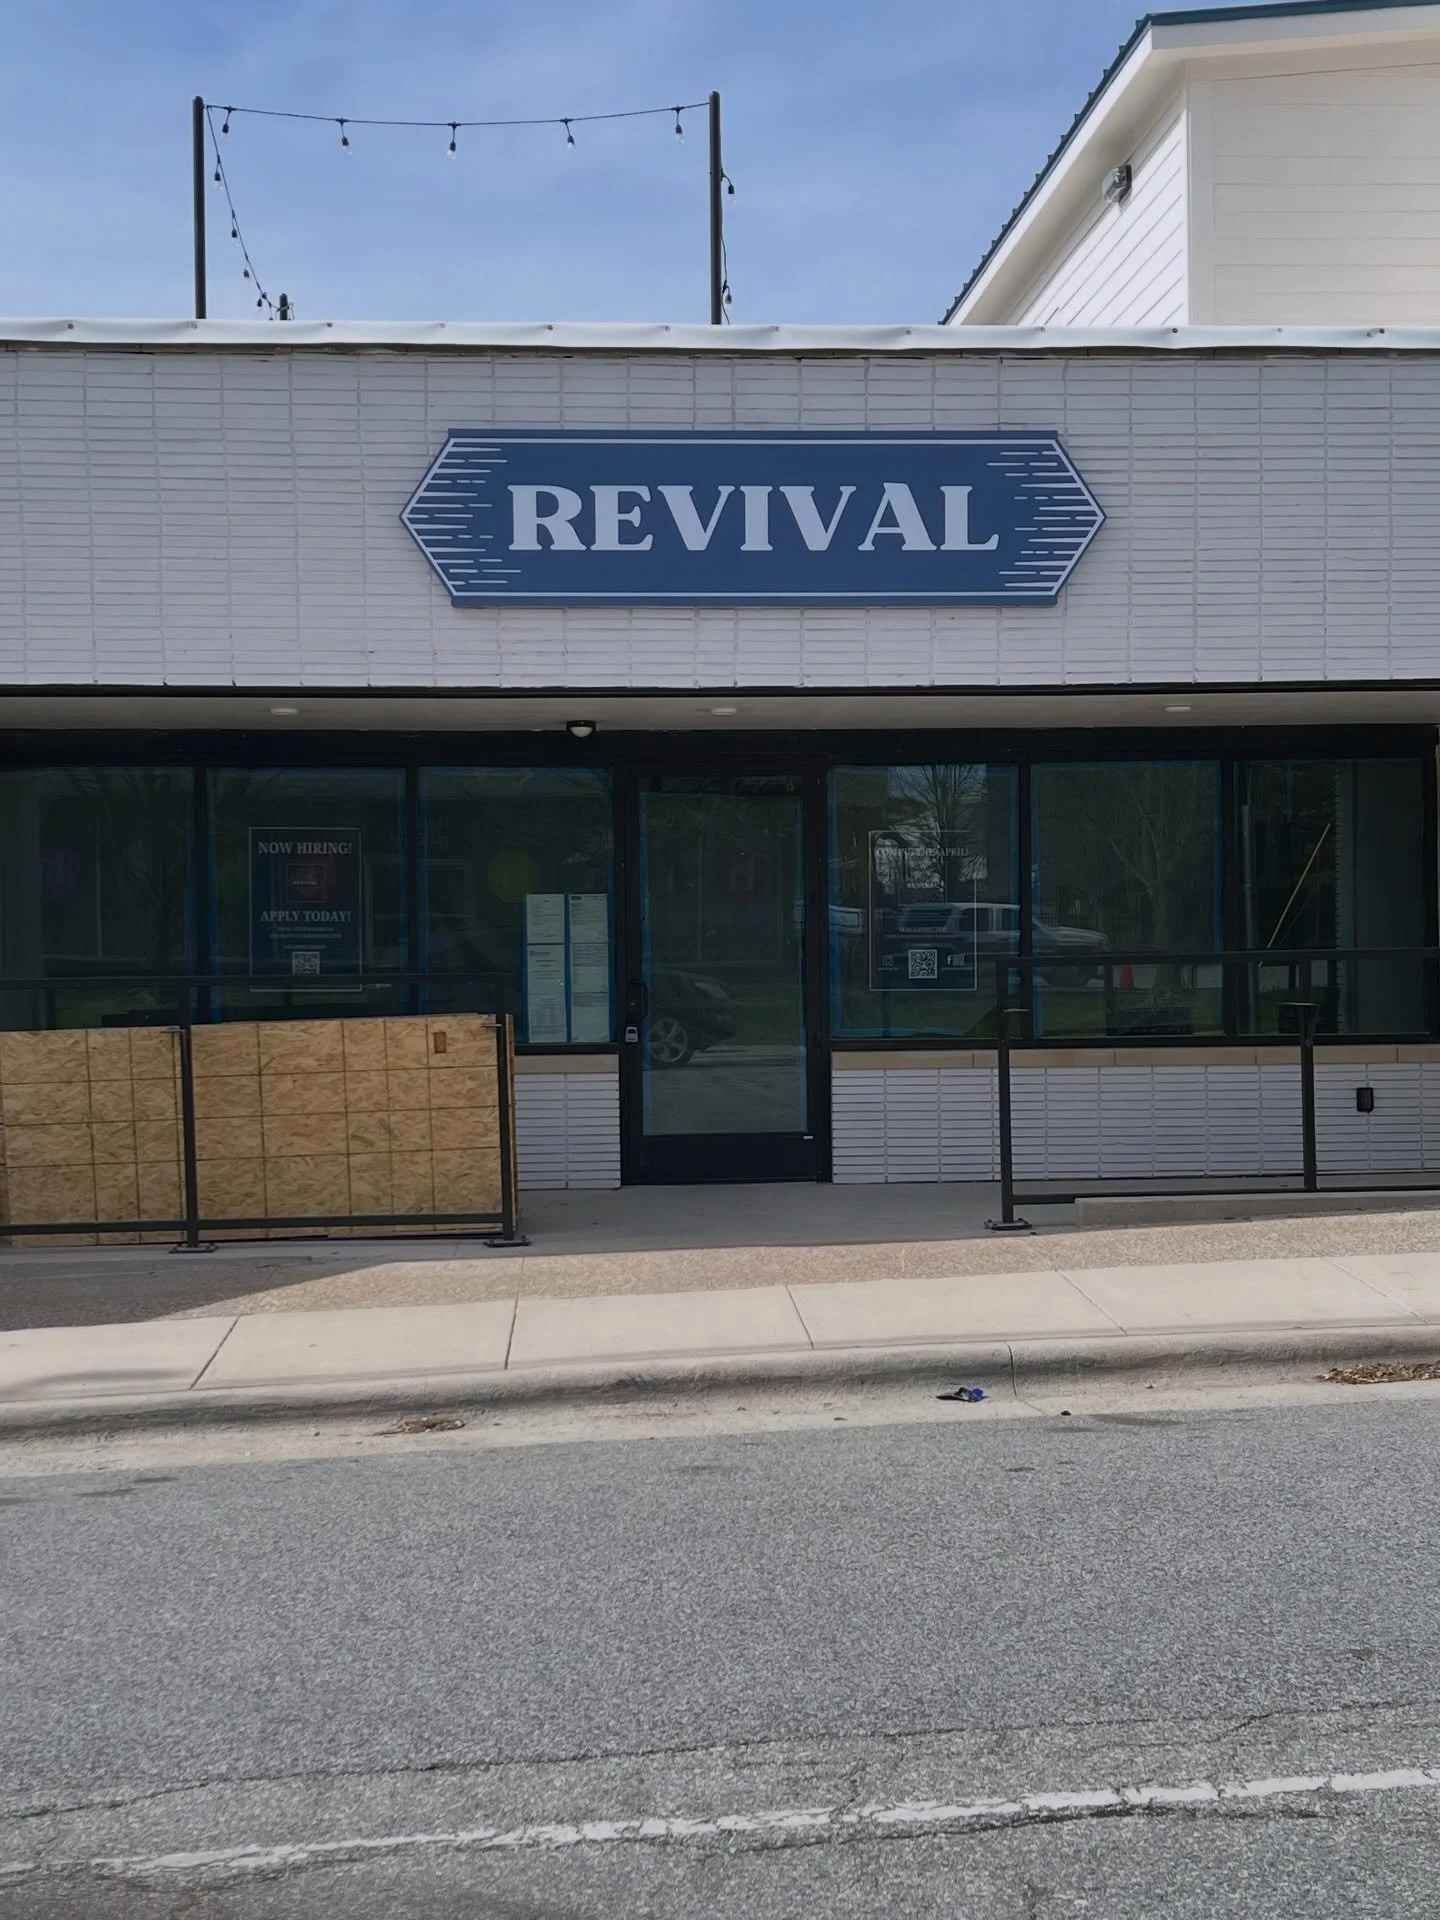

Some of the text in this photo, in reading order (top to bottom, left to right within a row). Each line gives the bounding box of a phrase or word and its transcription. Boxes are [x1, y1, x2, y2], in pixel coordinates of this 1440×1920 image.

[507, 482, 1000, 552] REVIVAL
[258, 842, 353, 855] NOW HIRING!
[260, 911, 353, 922] APPLY TODAY!
